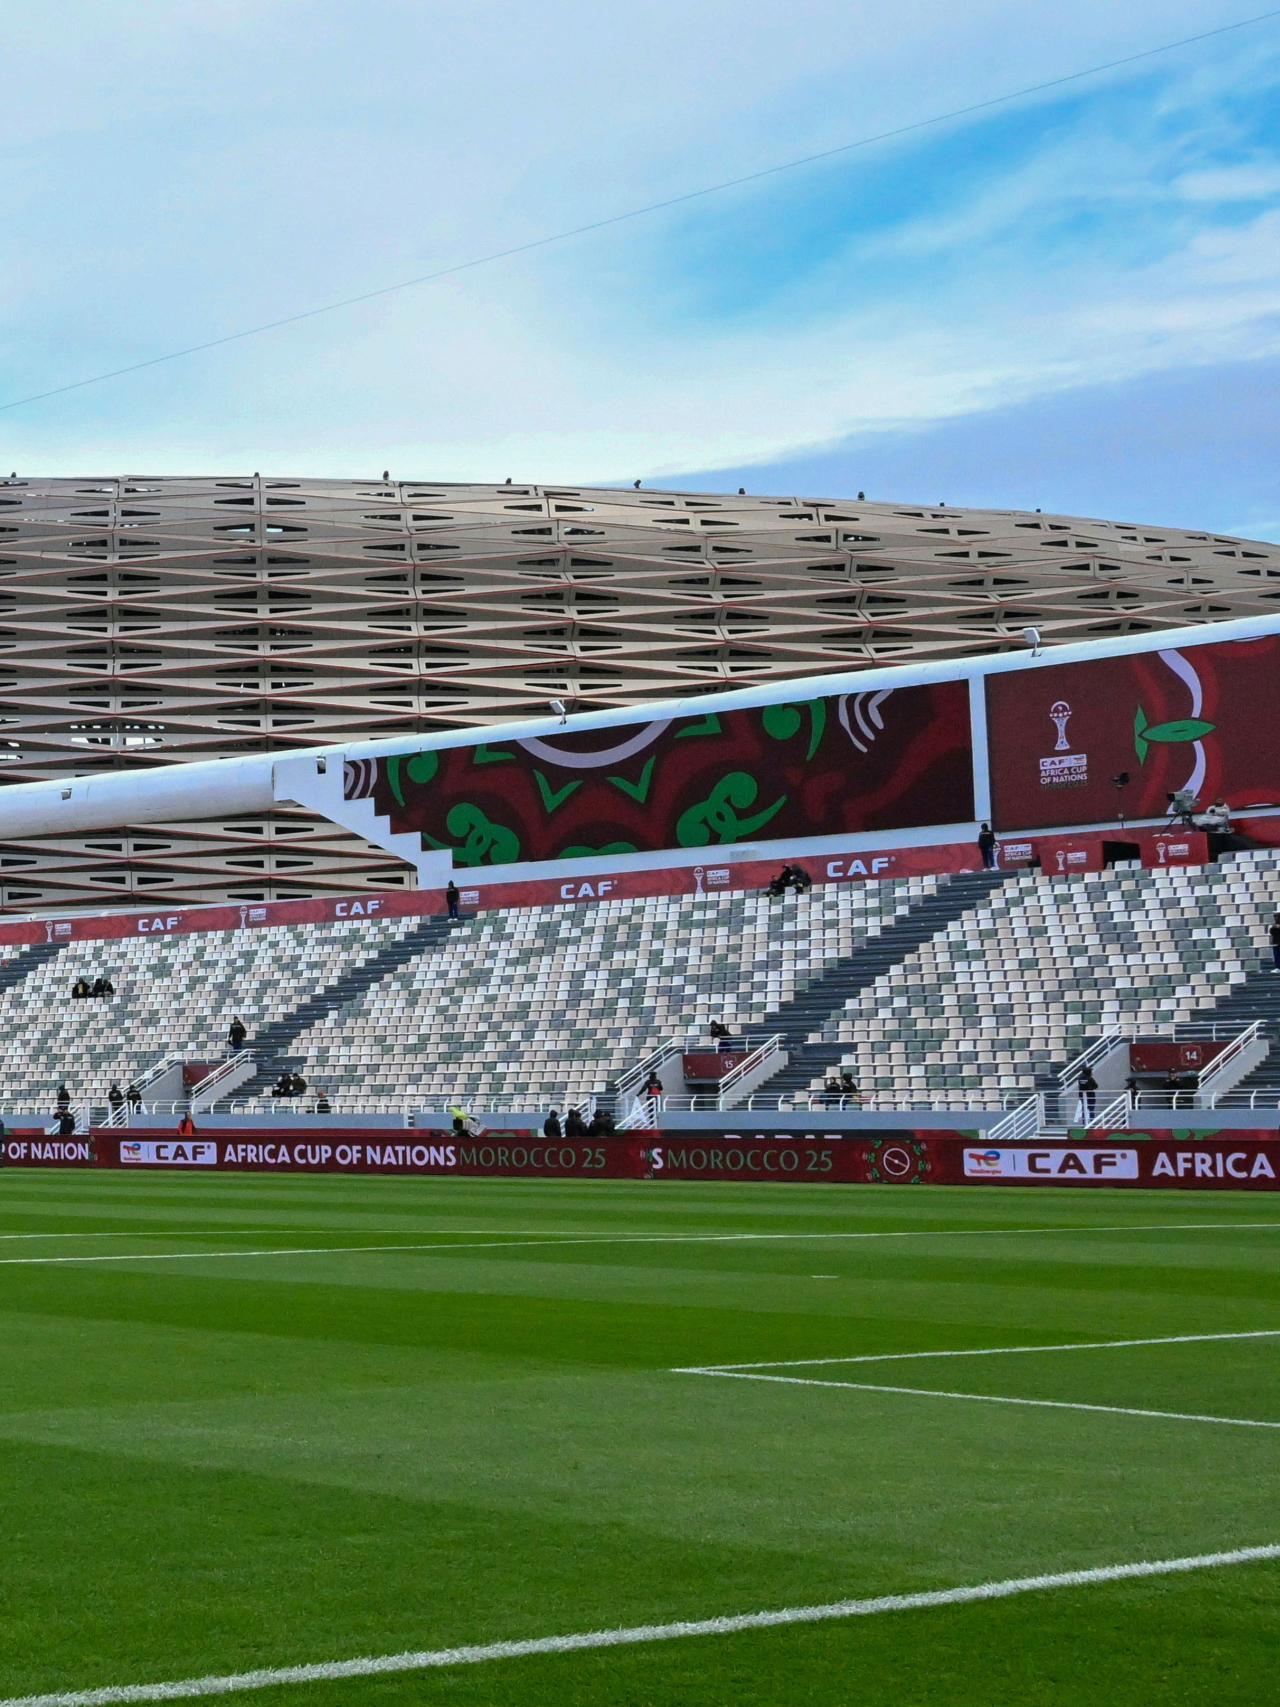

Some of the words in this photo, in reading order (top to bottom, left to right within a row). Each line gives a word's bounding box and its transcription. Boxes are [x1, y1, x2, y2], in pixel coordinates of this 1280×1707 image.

[1041, 759, 1065, 767] CAF
[1040, 768, 1069, 777] AFRICA
[1070, 766, 1087, 774] CUP
[1052, 773, 1087, 783] NATIONS
[827, 858, 890, 877] CAF
[560, 880, 612, 898] CAF
[335, 901, 379, 917] CAF
[138, 917, 178, 932] CAF
[1186, 1051, 1198, 1061] 14
[725, 1060, 734, 1069] 15
[8, 1142, 28, 1159] OF
[31, 1143, 89, 1160] NATION
[156, 1145, 206, 1161] CAF
[224, 1144, 291, 1163] AFRICA
[293, 1144, 332, 1164] CUP
[335, 1145, 361, 1164] OF
[366, 1145, 456, 1166] NATIONS
[459, 1147, 576, 1168] MOROCCO
[582, 1148, 605, 1168] 25
[667, 1149, 798, 1171] MOROCCO
[806, 1150, 832, 1171] 25
[1027, 1152, 1117, 1176] CAF
[1151, 1152, 1277, 1179] AFRICA
